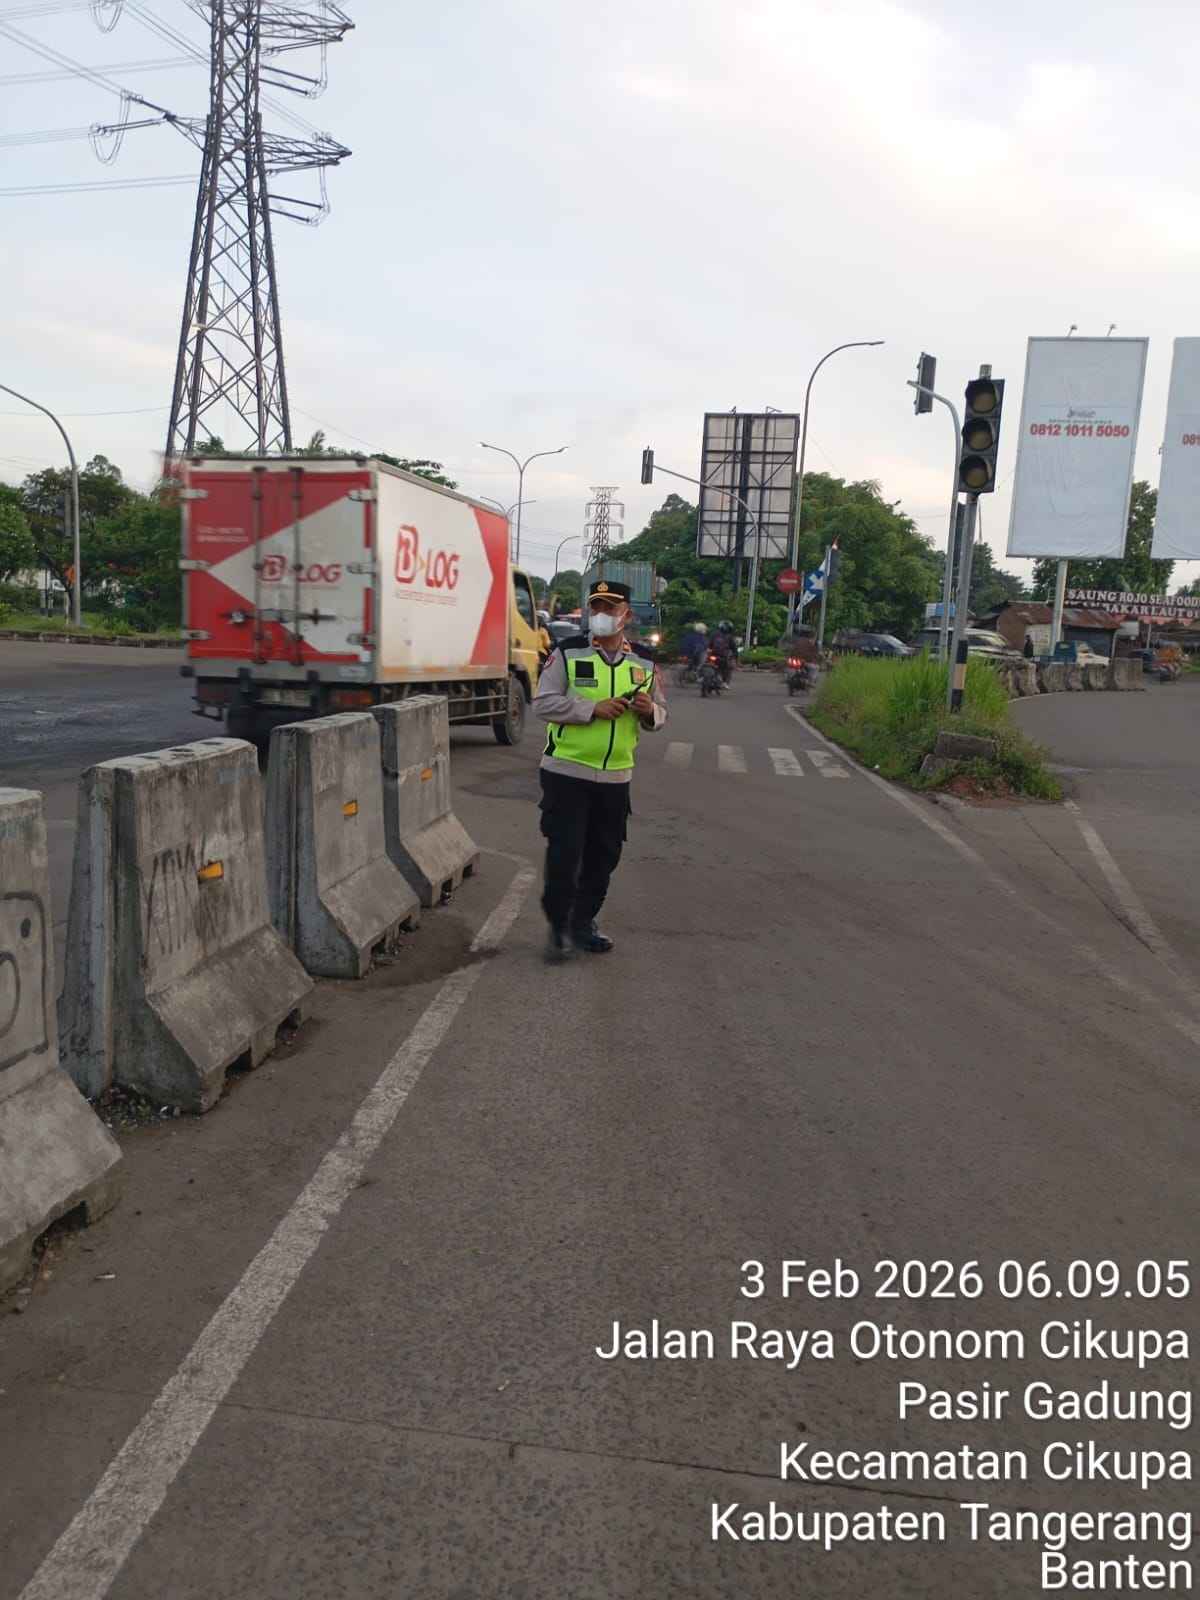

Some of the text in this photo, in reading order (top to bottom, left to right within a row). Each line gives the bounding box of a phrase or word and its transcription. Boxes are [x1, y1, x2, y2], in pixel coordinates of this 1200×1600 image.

[1030, 423, 1130, 437] 0812 1011 5050
[1067, 589, 1117, 602] SAUNG
